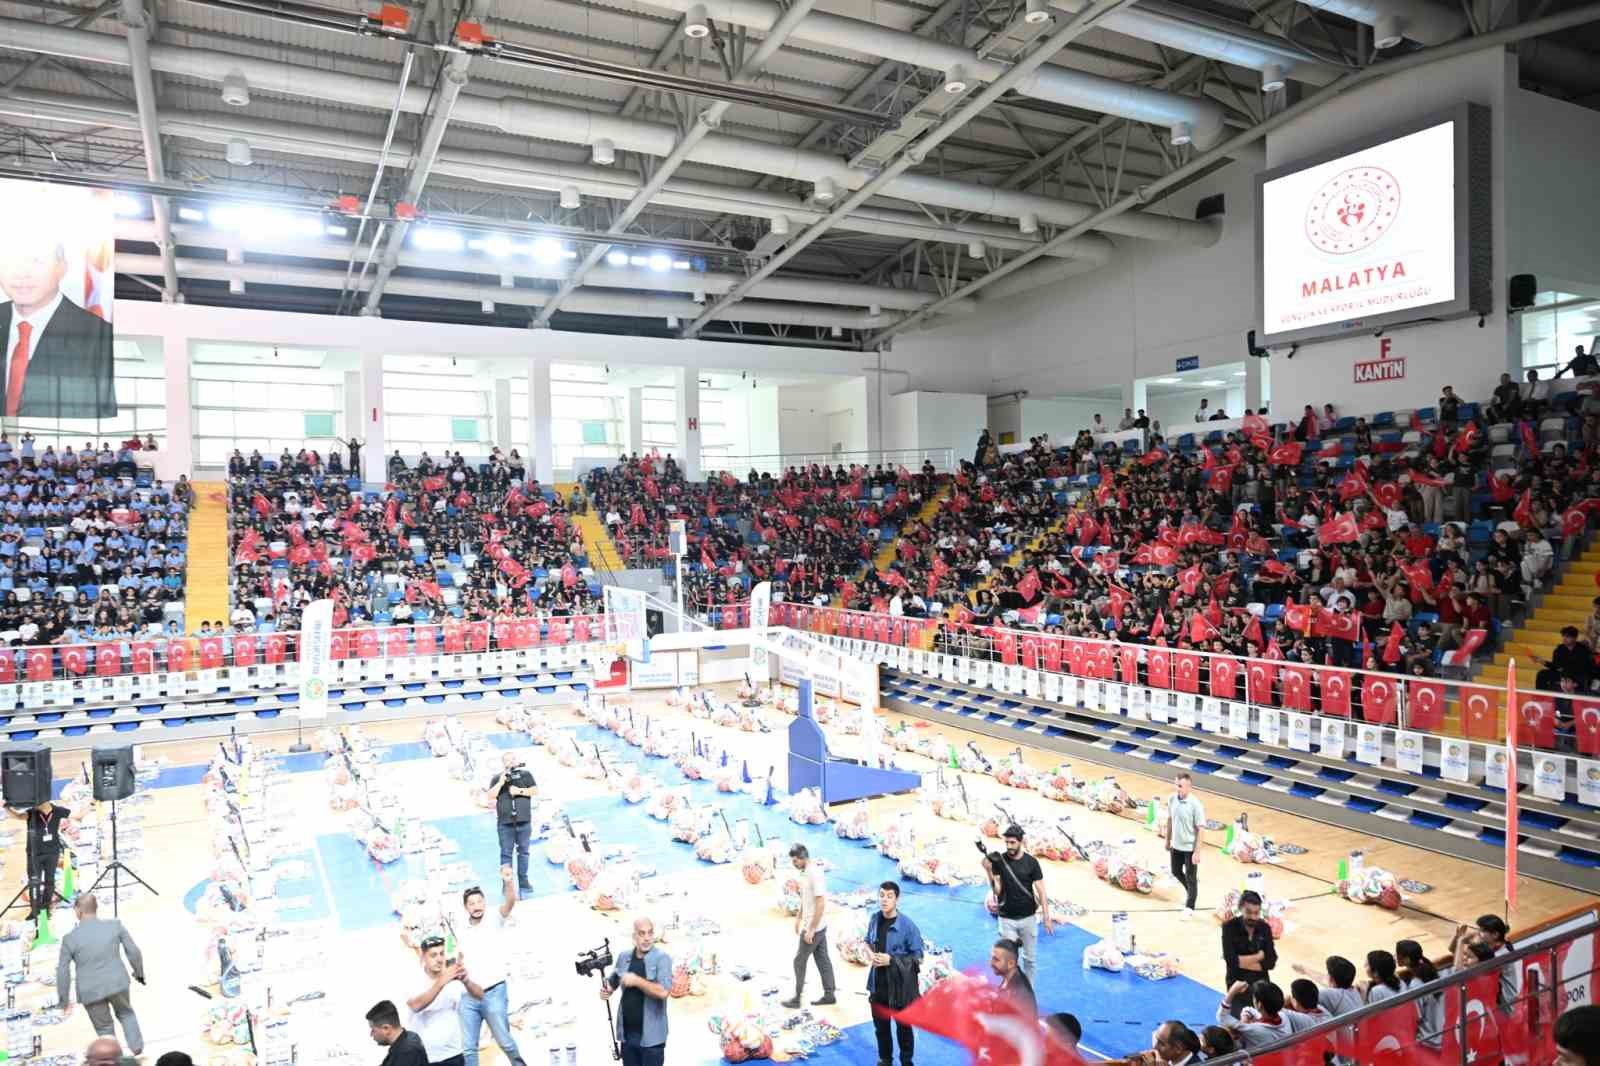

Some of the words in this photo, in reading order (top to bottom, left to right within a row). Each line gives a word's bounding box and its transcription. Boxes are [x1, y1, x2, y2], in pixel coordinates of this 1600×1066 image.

[1301, 261, 1406, 298] MALATYA
[1380, 338, 1392, 360] F
[1355, 360, 1403, 382] KANTİN
[688, 416, 698, 431] H
